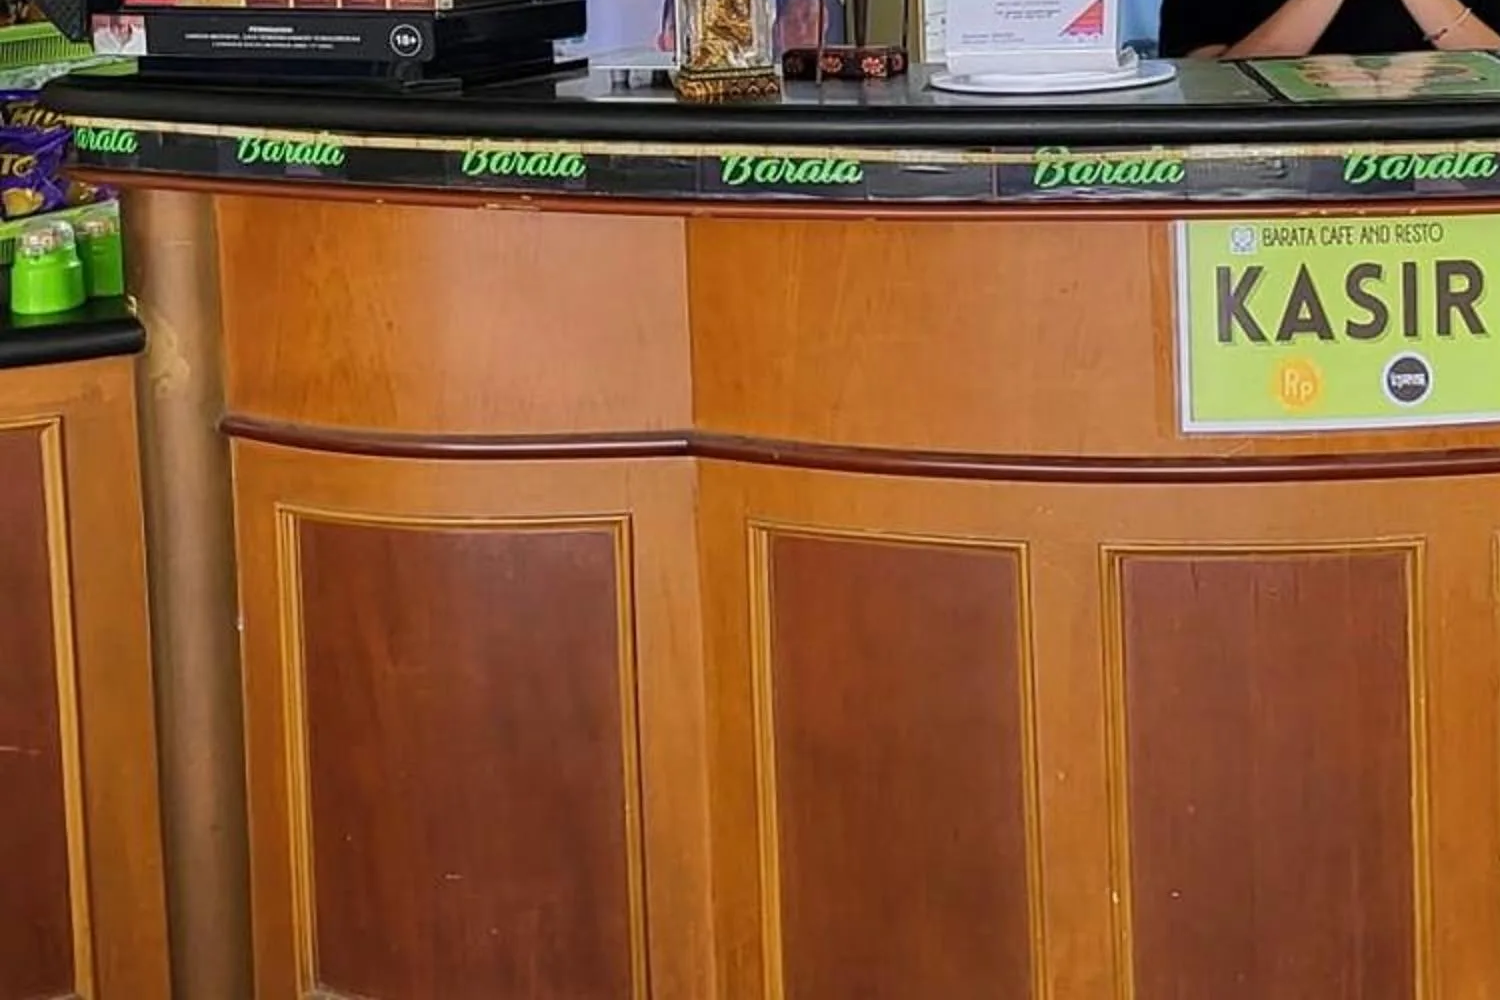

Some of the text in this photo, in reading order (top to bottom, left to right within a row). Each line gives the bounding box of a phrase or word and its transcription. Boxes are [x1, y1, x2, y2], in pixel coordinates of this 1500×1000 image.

[75, 127, 138, 154] arata
[234, 132, 347, 168] Barata
[459, 146, 588, 180] Barata
[719, 152, 866, 187] Barata
[1033, 145, 1186, 188] Barata
[1343, 147, 1500, 185] Barata
[1262, 222, 1445, 247] BARATA CAFE AND RESTO
[1215, 258, 1491, 345] KASIR
[1284, 369, 1314, 401] Rp
